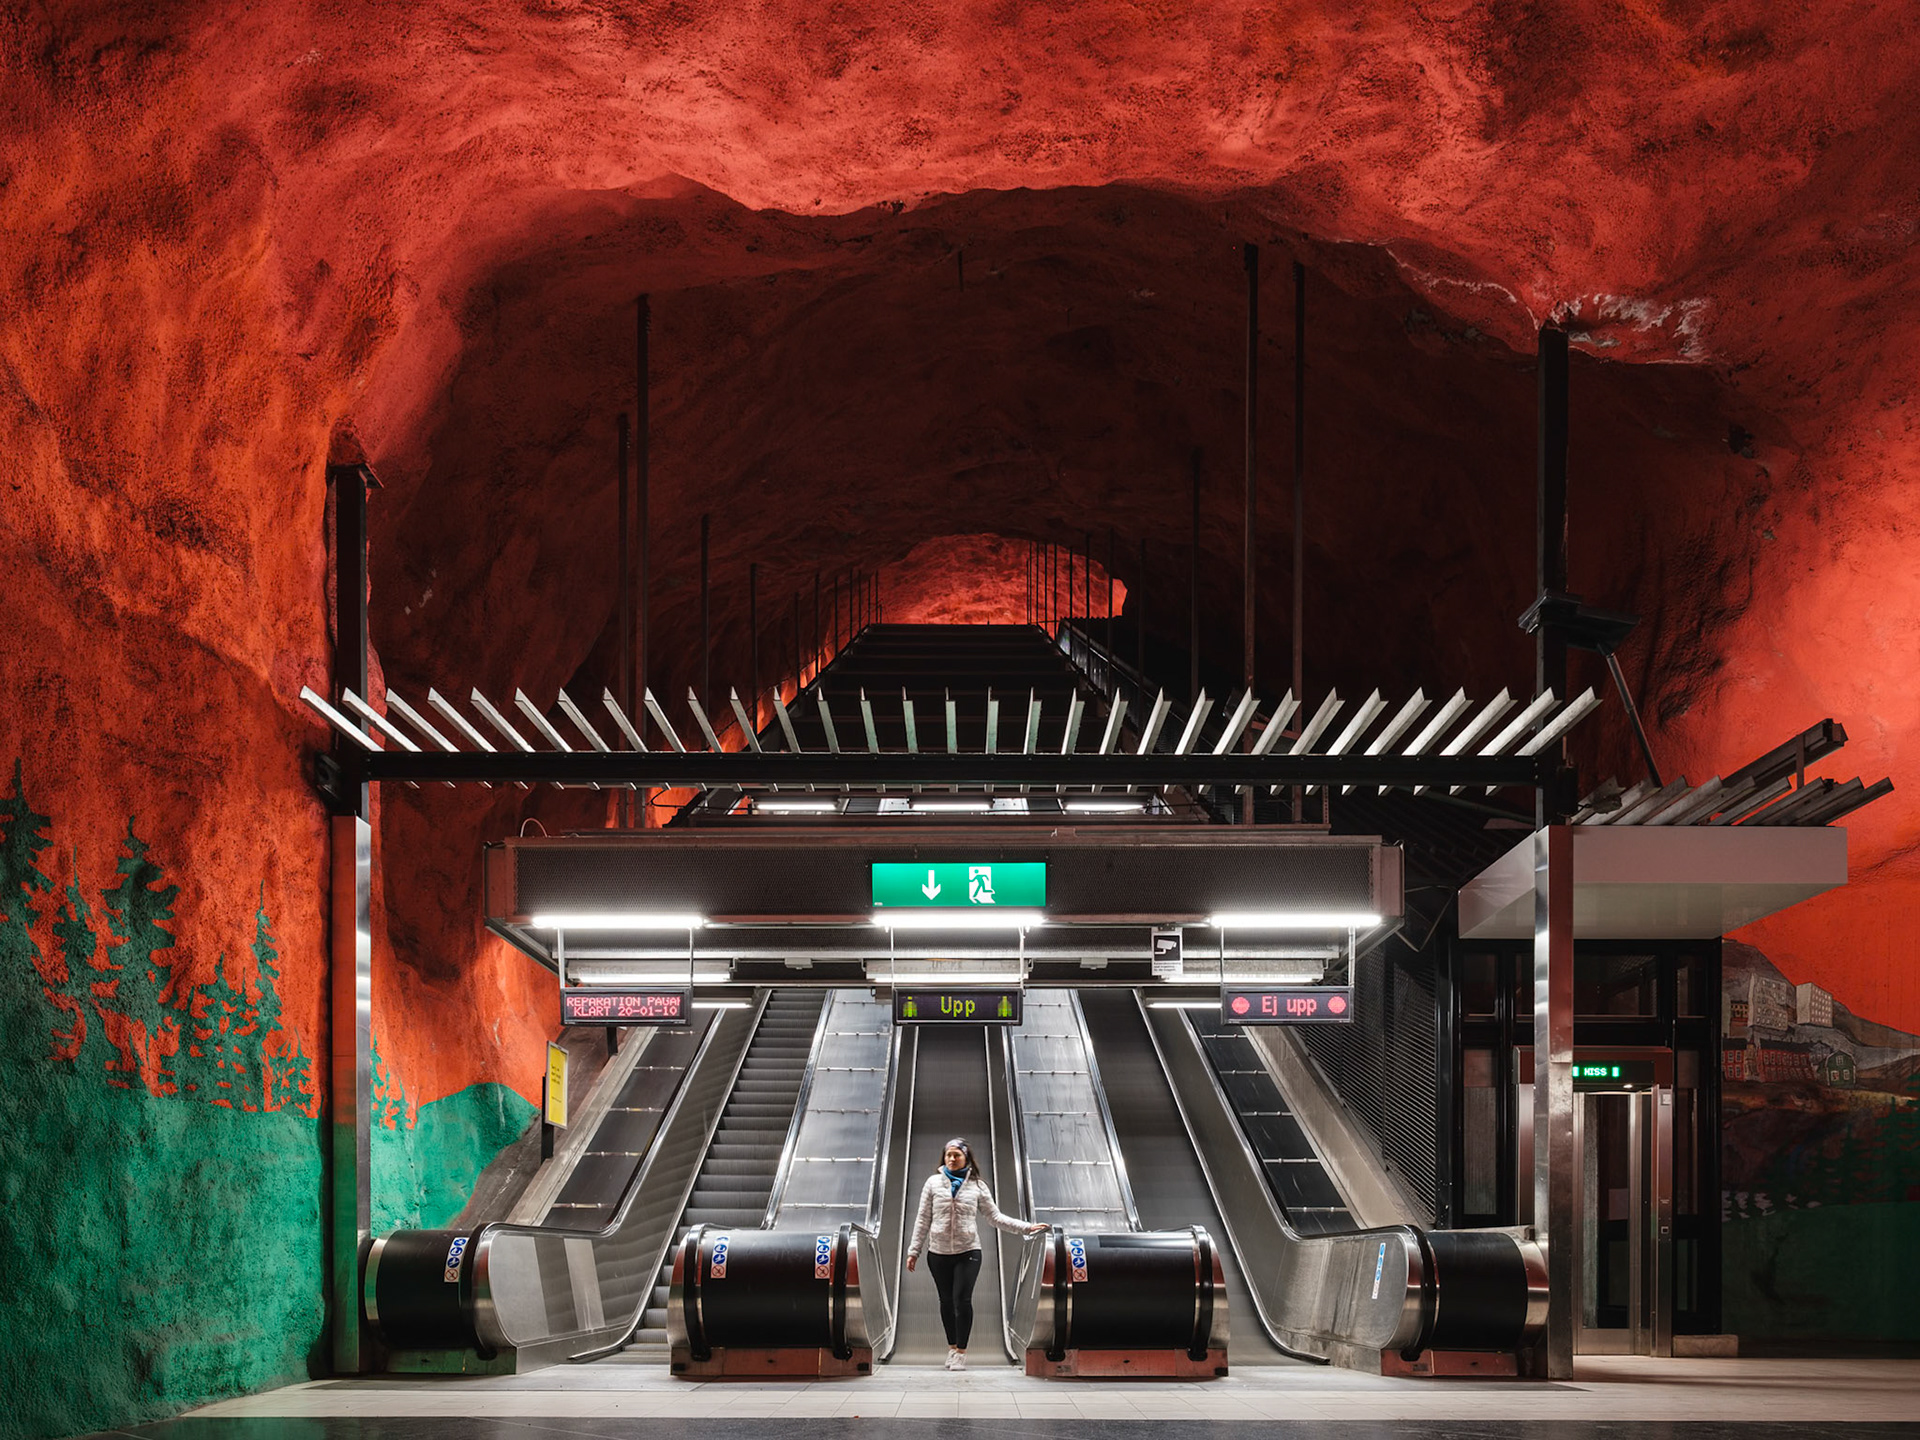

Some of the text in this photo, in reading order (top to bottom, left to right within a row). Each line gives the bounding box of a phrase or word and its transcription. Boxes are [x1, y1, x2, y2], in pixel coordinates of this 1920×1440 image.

[567, 996, 641, 1006] REPARATION
[1262, 995, 1317, 1016] Ej upp
[574, 1006, 678, 1016] KLART 20-01-10
[941, 996, 975, 1017] Upp
[1584, 1067, 1607, 1076] HISS
